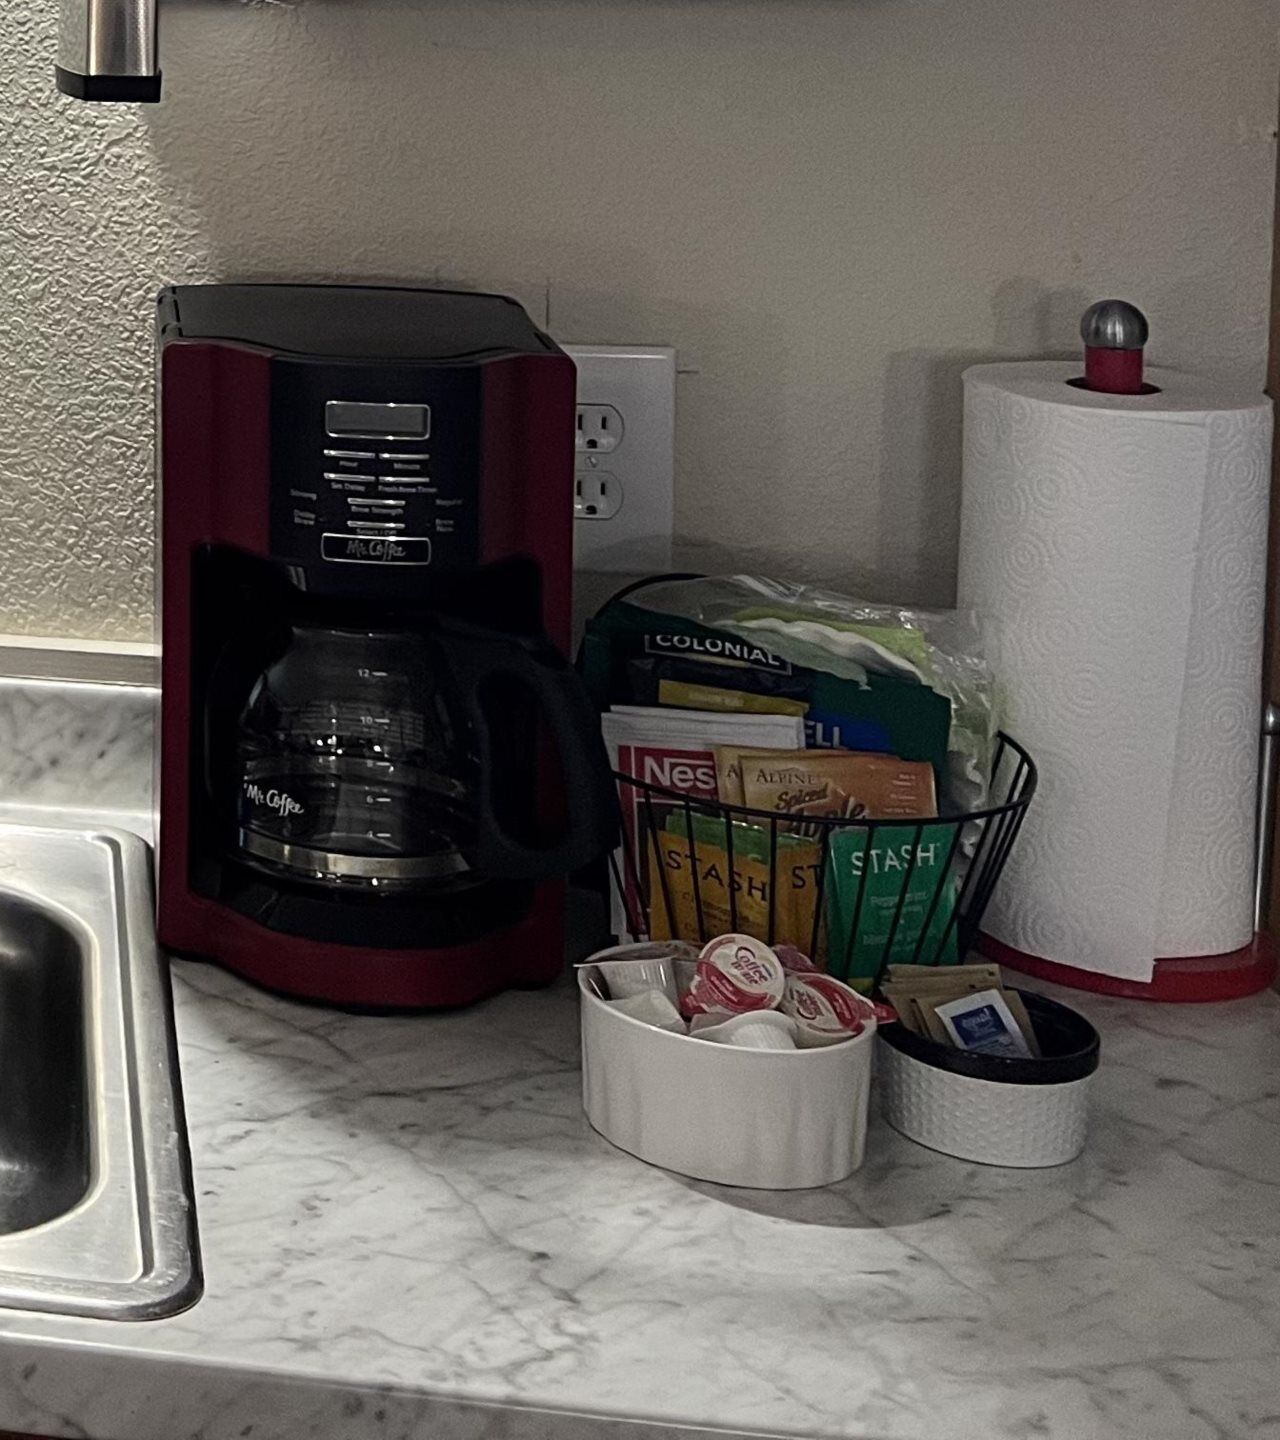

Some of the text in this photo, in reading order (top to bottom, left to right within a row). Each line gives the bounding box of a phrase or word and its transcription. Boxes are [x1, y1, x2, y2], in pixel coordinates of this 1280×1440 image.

[655, 634, 781, 666] COLONIAL
[755, 767, 816, 786] ALPINE
[266, 789, 305, 817] Coffee
[850, 843, 937, 876] STASH
